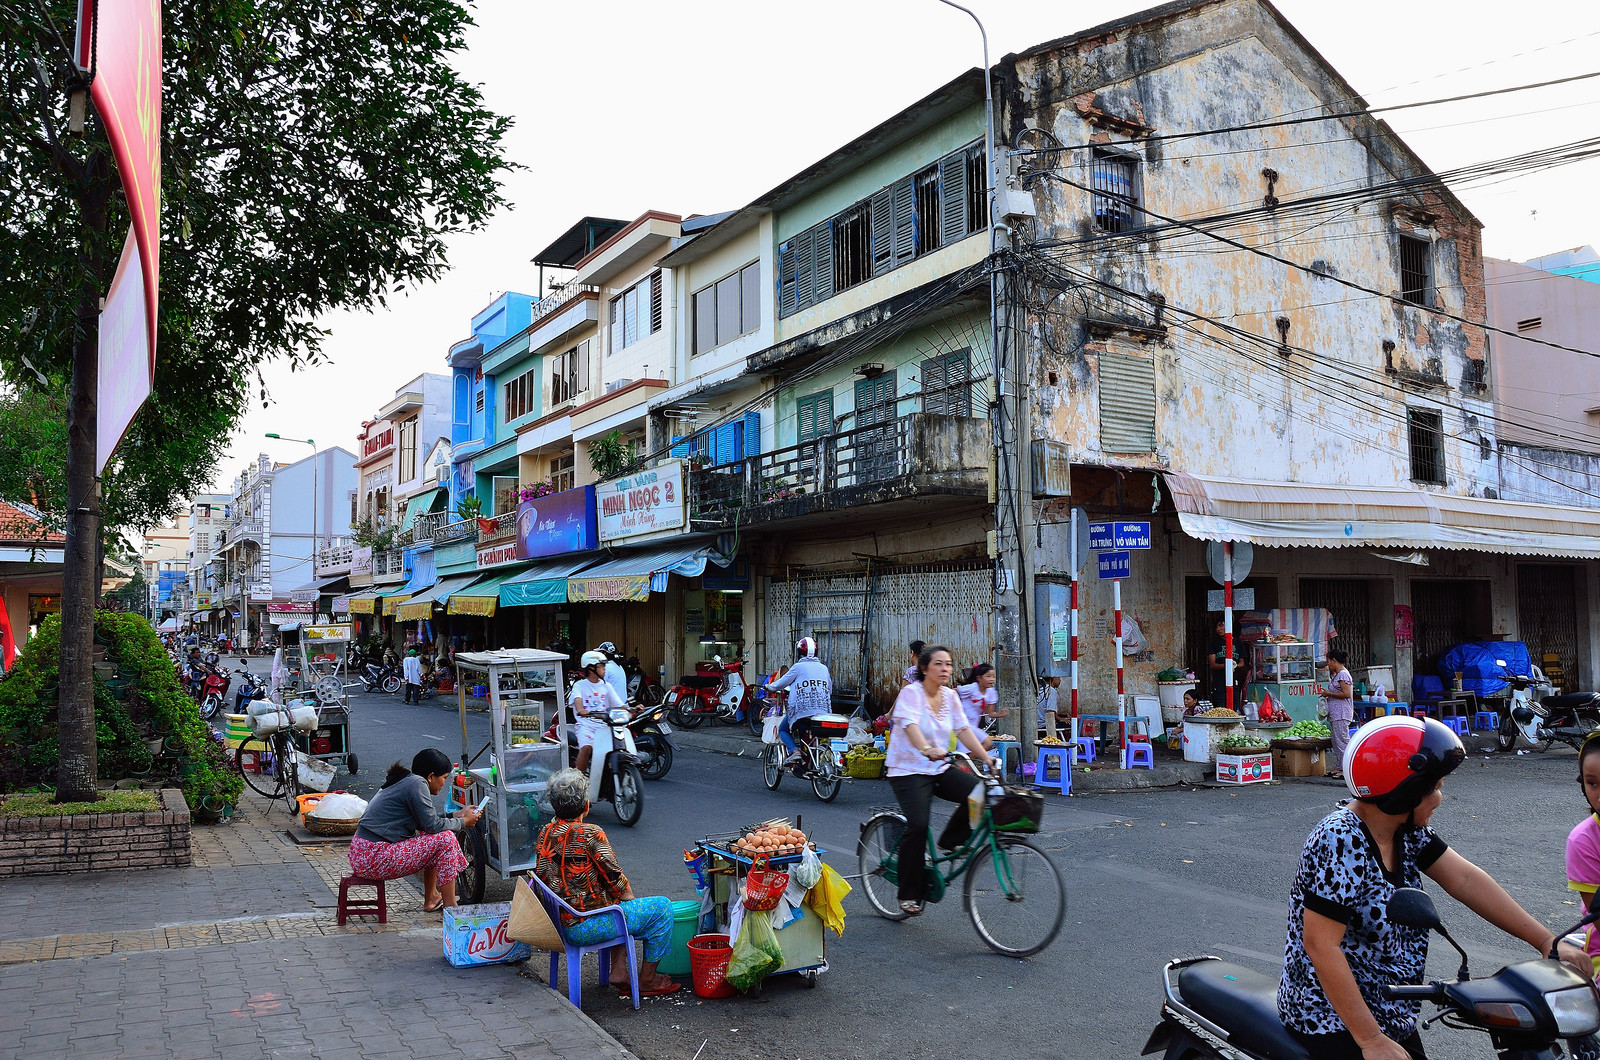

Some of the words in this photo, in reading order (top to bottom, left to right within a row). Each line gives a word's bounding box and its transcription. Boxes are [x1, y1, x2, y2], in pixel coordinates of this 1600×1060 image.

[602, 493, 627, 518] MINH
[628, 485, 661, 513] NGỌC
[664, 480, 676, 503] 2
[1090, 525, 1106, 533] ĐƯỜNG
[1123, 524, 1141, 532] ĐƯỜNG
[1116, 537, 1124, 547] VÕ
[1125, 537, 1137, 546] VĂN
[504, 544, 517, 562] PHÁ
[587, 580, 603, 597] MINH
[1288, 685, 1305, 696] CƠM
[1307, 681, 1322, 695] TẤM
